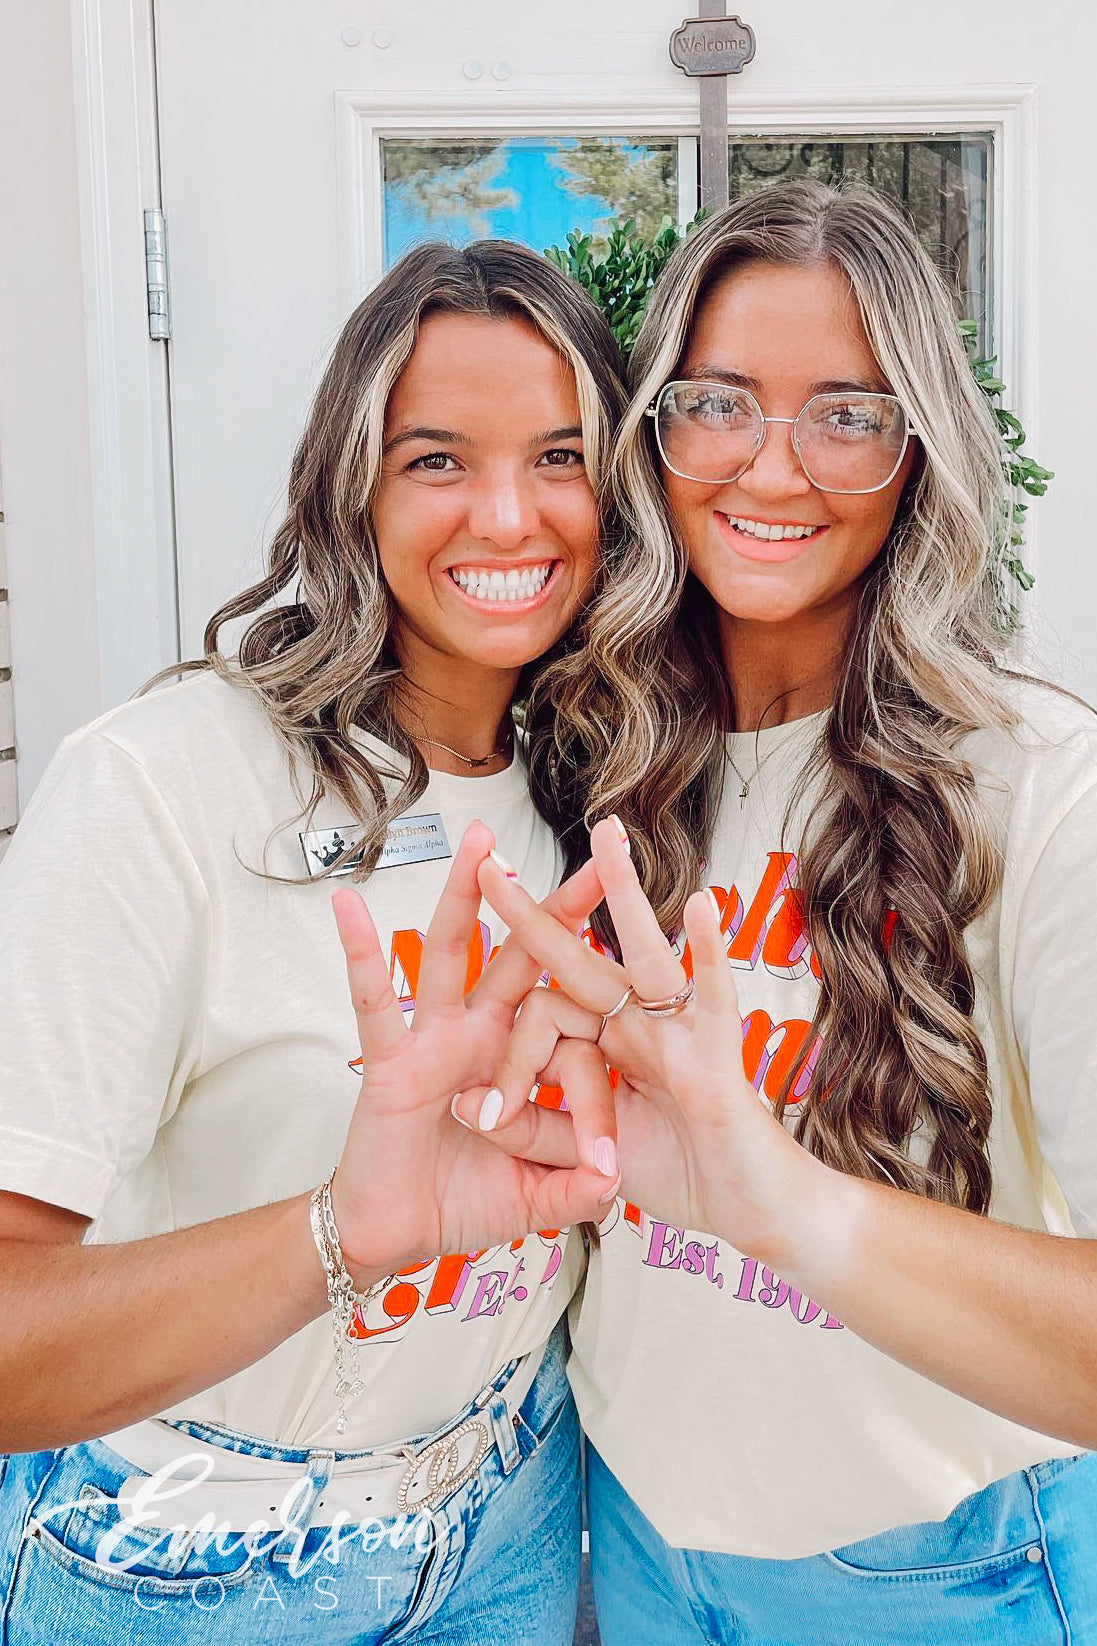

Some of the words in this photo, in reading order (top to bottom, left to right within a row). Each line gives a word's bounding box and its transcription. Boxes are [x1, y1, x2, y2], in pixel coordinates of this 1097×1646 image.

[677, 36, 746, 53] Welcome
[406, 825, 438, 836] Brown
[401, 844, 422, 853] Sigma
[424, 840, 443, 850] Alpha
